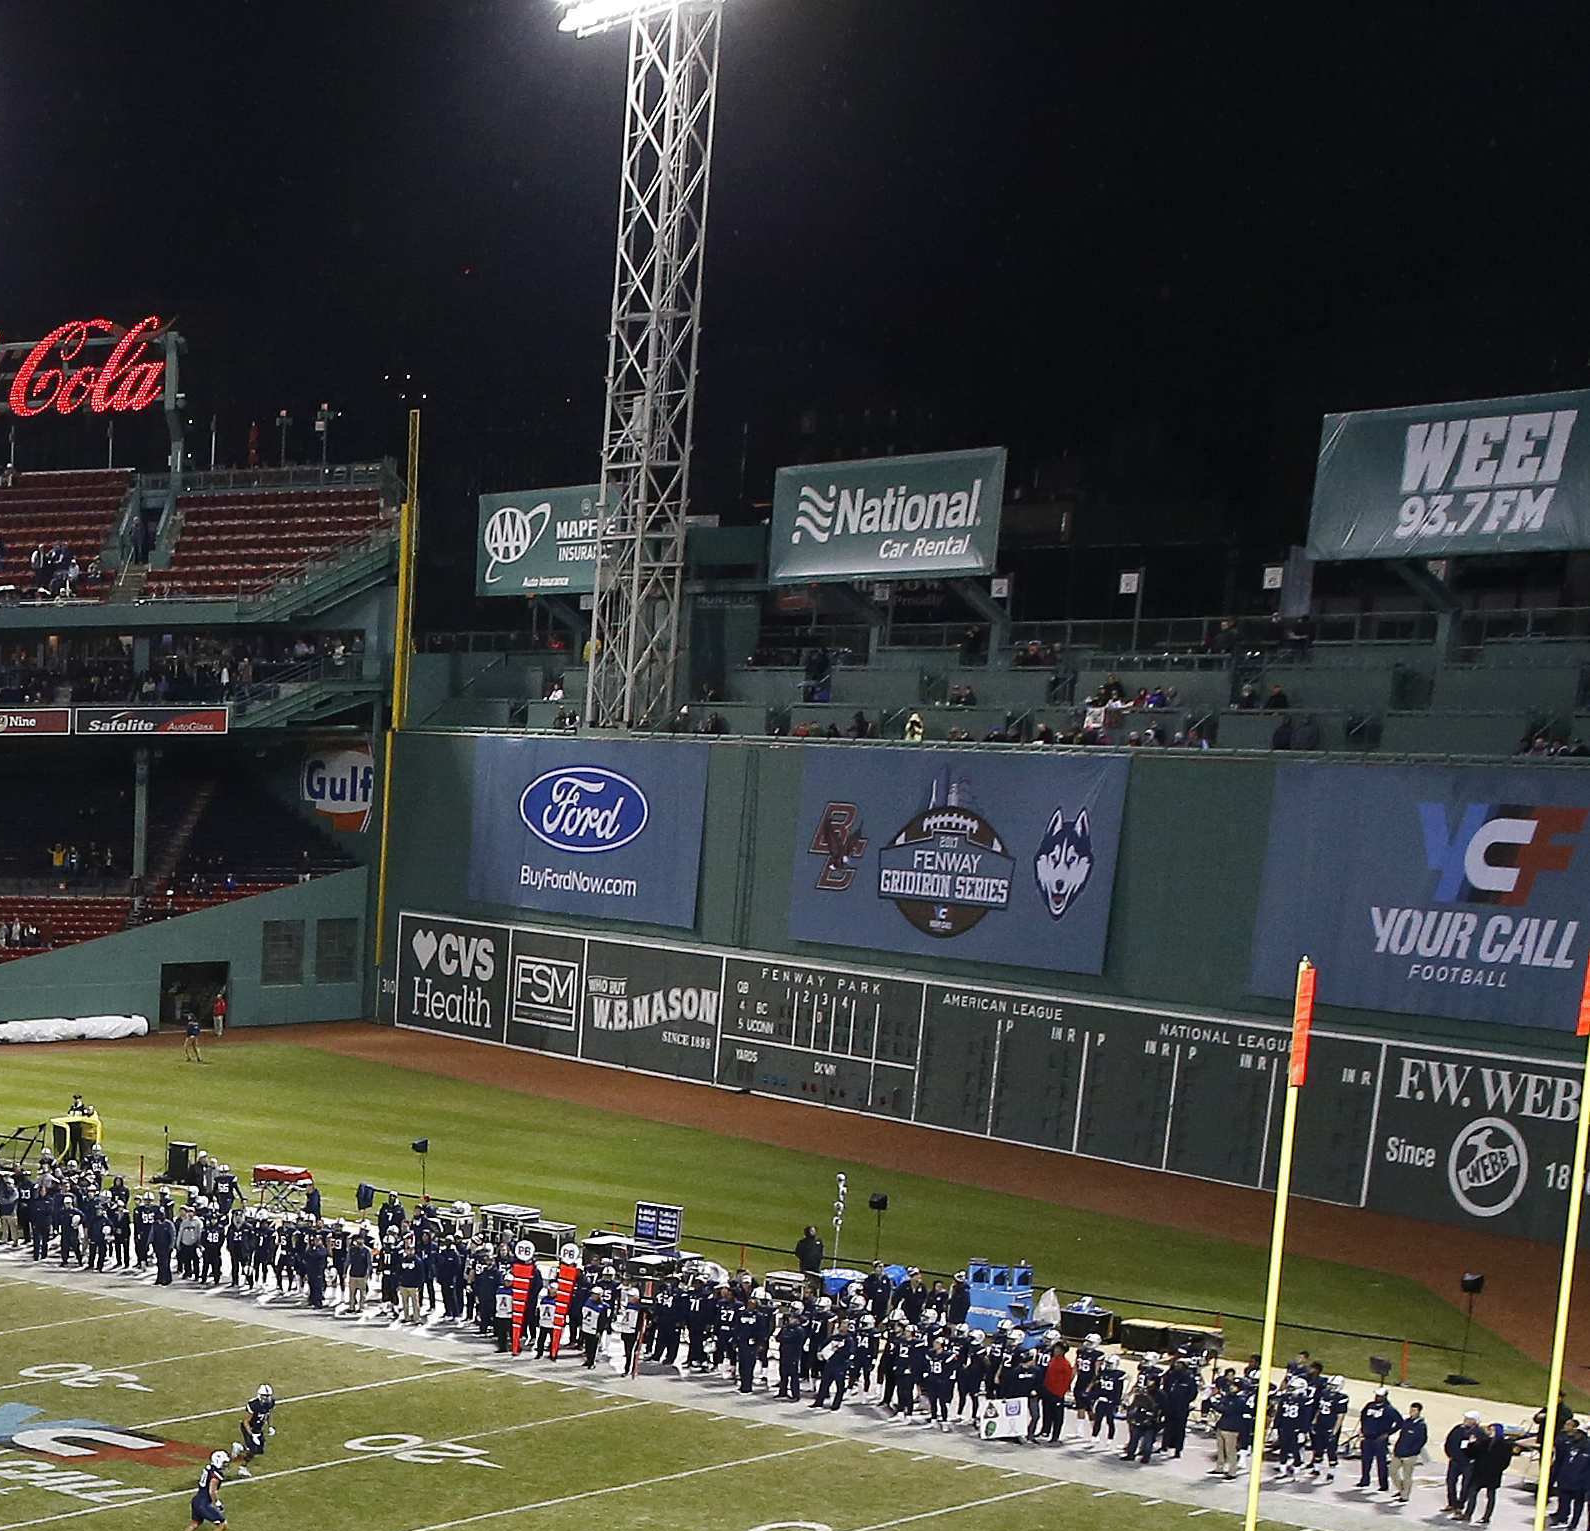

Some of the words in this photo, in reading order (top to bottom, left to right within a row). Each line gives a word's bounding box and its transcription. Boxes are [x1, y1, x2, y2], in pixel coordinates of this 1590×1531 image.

[1400, 409, 1578, 494] WEEI
[490, 510, 524, 561] AAA
[556, 517, 617, 539] MAPFE
[878, 539, 907, 559] Car
[911, 534, 971, 557] Rental
[9, 716, 36, 729] Nine
[88, 714, 156, 732] Safelite
[166, 721, 215, 732] AutoGlass
[306, 760, 373, 802] Gulf
[542, 776, 624, 840] Ford
[913, 849, 982, 874] FENWAY
[520, 864, 637, 897] BuyFordNow.com
[880, 868, 951, 898] GRIDIRON
[955, 876, 1009, 904] SERIES
[1371, 906, 1478, 960] YOUR
[1478, 914, 1579, 969] CALL
[438, 932, 495, 982] CVS
[517, 962, 575, 1008] FSM
[762, 968, 826, 987] FENWAY
[837, 978, 882, 995] PARK
[1408, 964, 1508, 988] FOOTBALL
[588, 978, 607, 994] WHO
[608, 979, 627, 997] BUT
[803, 991, 810, 1003] 2
[412, 975, 492, 1029] Health
[756, 1002, 768, 1015] BC
[821, 993, 829, 1006] 3
[841, 996, 849, 1009] 4
[943, 993, 1007, 1013] AMERICAN
[1012, 1004, 1064, 1021] LEAGUE
[746, 1018, 774, 1035] UCONN
[1006, 1019, 1014, 1033] P
[1051, 1026, 1062, 1041] IN
[1066, 1028, 1076, 1043] R
[1159, 1023, 1231, 1045] NATIONAL
[661, 1030, 689, 1047] SINCE
[1097, 1033, 1106, 1047] P
[1161, 1041, 1170, 1057] R
[735, 1049, 758, 1063] YARDS
[1188, 1046, 1197, 1060] P
[1257, 1055, 1267, 1071] R
[814, 1061, 837, 1076] DOWN
[1341, 1067, 1356, 1084] IN
[1361, 1070, 1372, 1086] R
[1396, 1057, 1474, 1108] F.W.
[1480, 1067, 1582, 1123] WEB
[1385, 1136, 1437, 1168] Since
[1467, 1150, 1509, 1184] WEBB
[721, 1310, 735, 1323] 27
[19, 1363, 140, 1389] 30
[344, 1434, 489, 1463] 20
